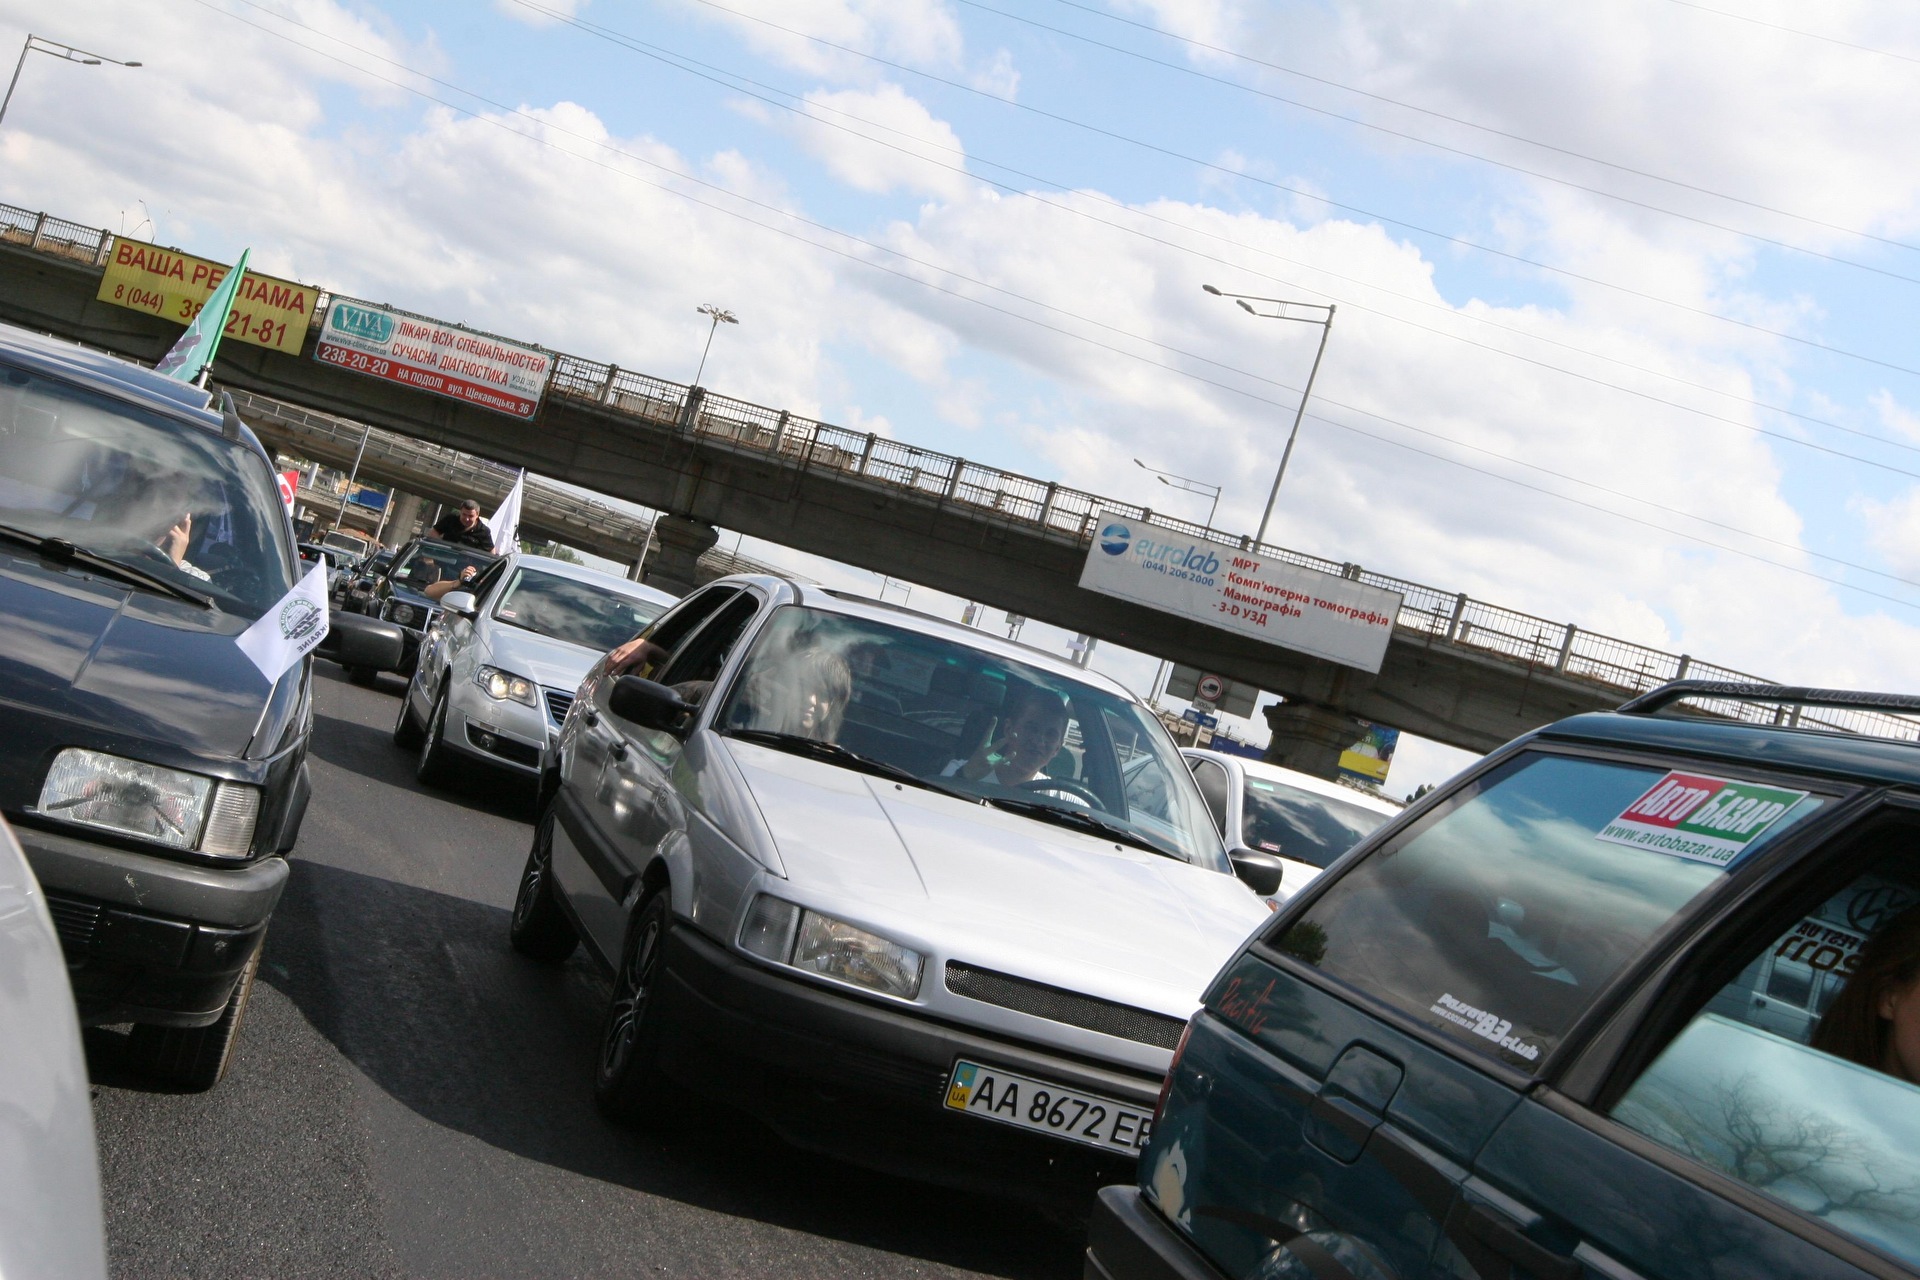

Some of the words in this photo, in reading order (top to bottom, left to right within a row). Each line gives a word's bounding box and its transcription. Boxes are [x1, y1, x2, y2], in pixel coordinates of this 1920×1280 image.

[116, 244, 184, 281] ВАША
[191, 264, 305, 314] РЕЛАМА
[114, 284, 125, 299] 8
[127, 286, 164, 314] (044)
[341, 306, 383, 331] VIVA
[322, 346, 390, 376] 238-20-20
[392, 343, 437, 366] СУЧАСНА
[438, 354, 509, 386] ДІАГНОСТИКА
[398, 322, 430, 343] ЛІКАРІ
[432, 330, 454, 348] ВСІХ
[456, 336, 547, 374] СПЕЦІАЛЬНОСТЕЙ
[397, 368, 409, 381] НА
[410, 371, 444, 389] ПОДОЛІ
[447, 383, 464, 396] вул.
[518, 402, 530, 415] 36
[1135, 537, 1220, 576] eurolab
[1142, 559, 1167, 576] (044)
[1169, 566, 1187, 580] 206
[1189, 572, 1215, 588] 2000
[1232, 557, 1260, 573] МРТ
[1224, 587, 1301, 618] Мамографія
[1228, 573, 1311, 604] Комп'ютерна
[1313, 597, 1389, 626] томографія
[1242, 608, 1268, 627] УЗД
[1602, 824, 1735, 862] www.avtobazar.ua
[952, 1091, 966, 1103] UA
[969, 1076, 1019, 1117] AA
[1028, 1090, 1107, 1139] 8672
